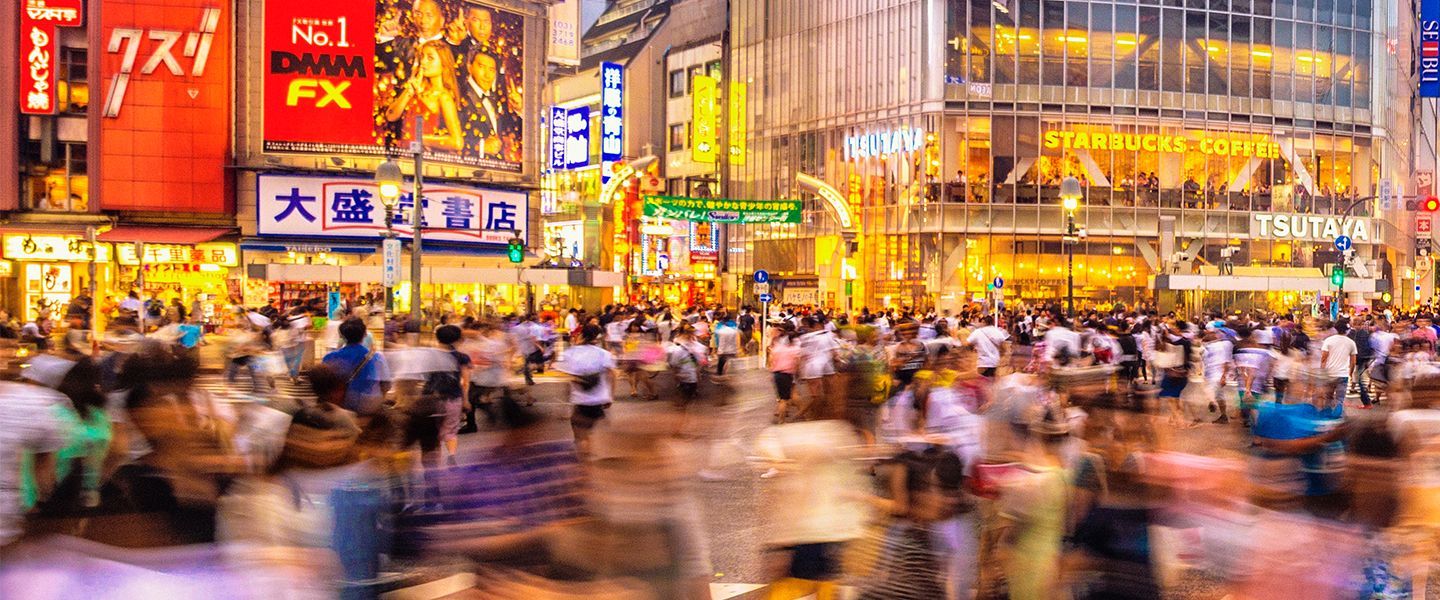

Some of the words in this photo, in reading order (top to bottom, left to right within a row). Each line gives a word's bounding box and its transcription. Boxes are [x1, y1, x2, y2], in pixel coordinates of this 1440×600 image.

[102, 8, 221, 118] クスリ
[271, 50, 367, 79] DMM
[1422, 21, 1439, 82] SEIBU
[28, 26, 49, 110] もんじゃ焼
[286, 77, 352, 109] FX
[845, 128, 922, 158] TSUTAYA
[1044, 130, 1187, 153] STARBUCKS
[1199, 137, 1280, 159] COFFEE
[274, 187, 516, 234] 大盛堂書店
[1255, 214, 1368, 241] TSUTAYA
[127, 248, 226, 263] 三千里薬品
